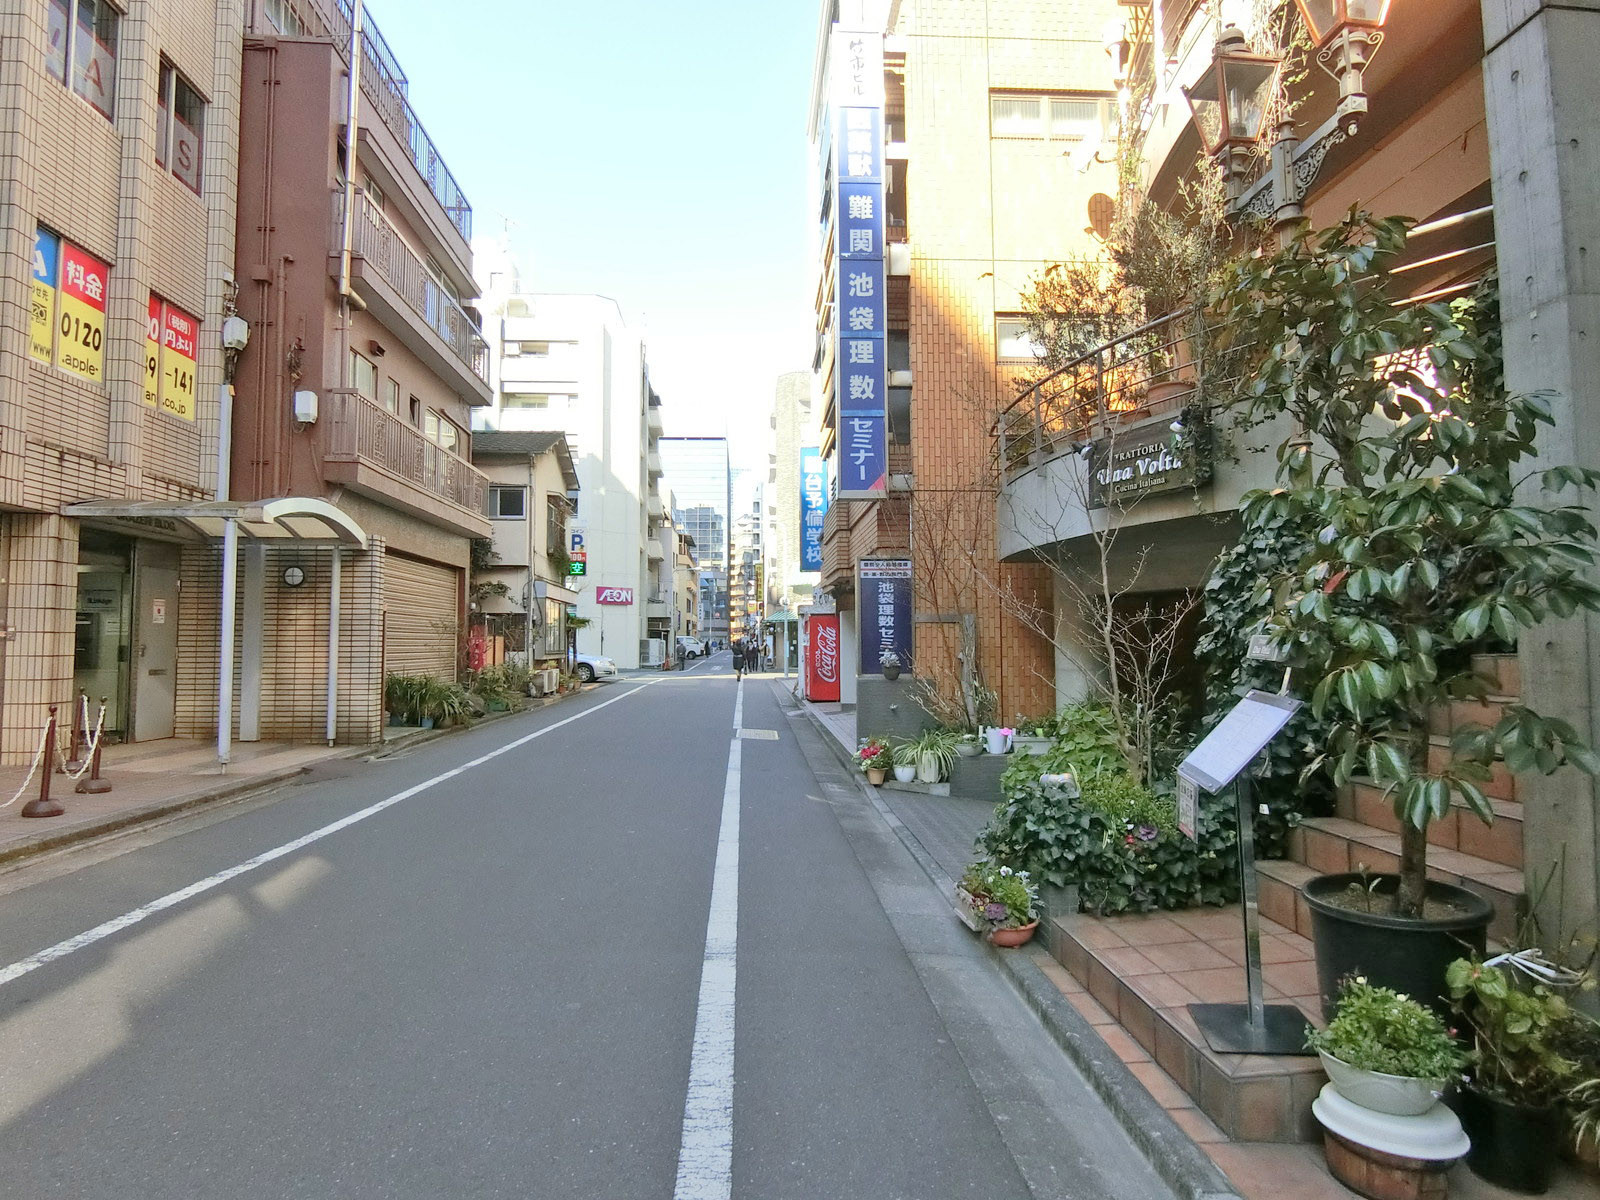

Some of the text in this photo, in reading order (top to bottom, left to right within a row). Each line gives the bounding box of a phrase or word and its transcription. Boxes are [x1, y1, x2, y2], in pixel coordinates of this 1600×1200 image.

[66, 260, 102, 302] 料金
[61, 312, 102, 351] 0120
[165, 328, 193, 357] 円より
[1114, 442, 1165, 461] TRATTORIA
[1114, 476, 1166, 494] Cucina Italiana
[571, 534, 584, 551] P
[571, 562, 584, 574] 空
